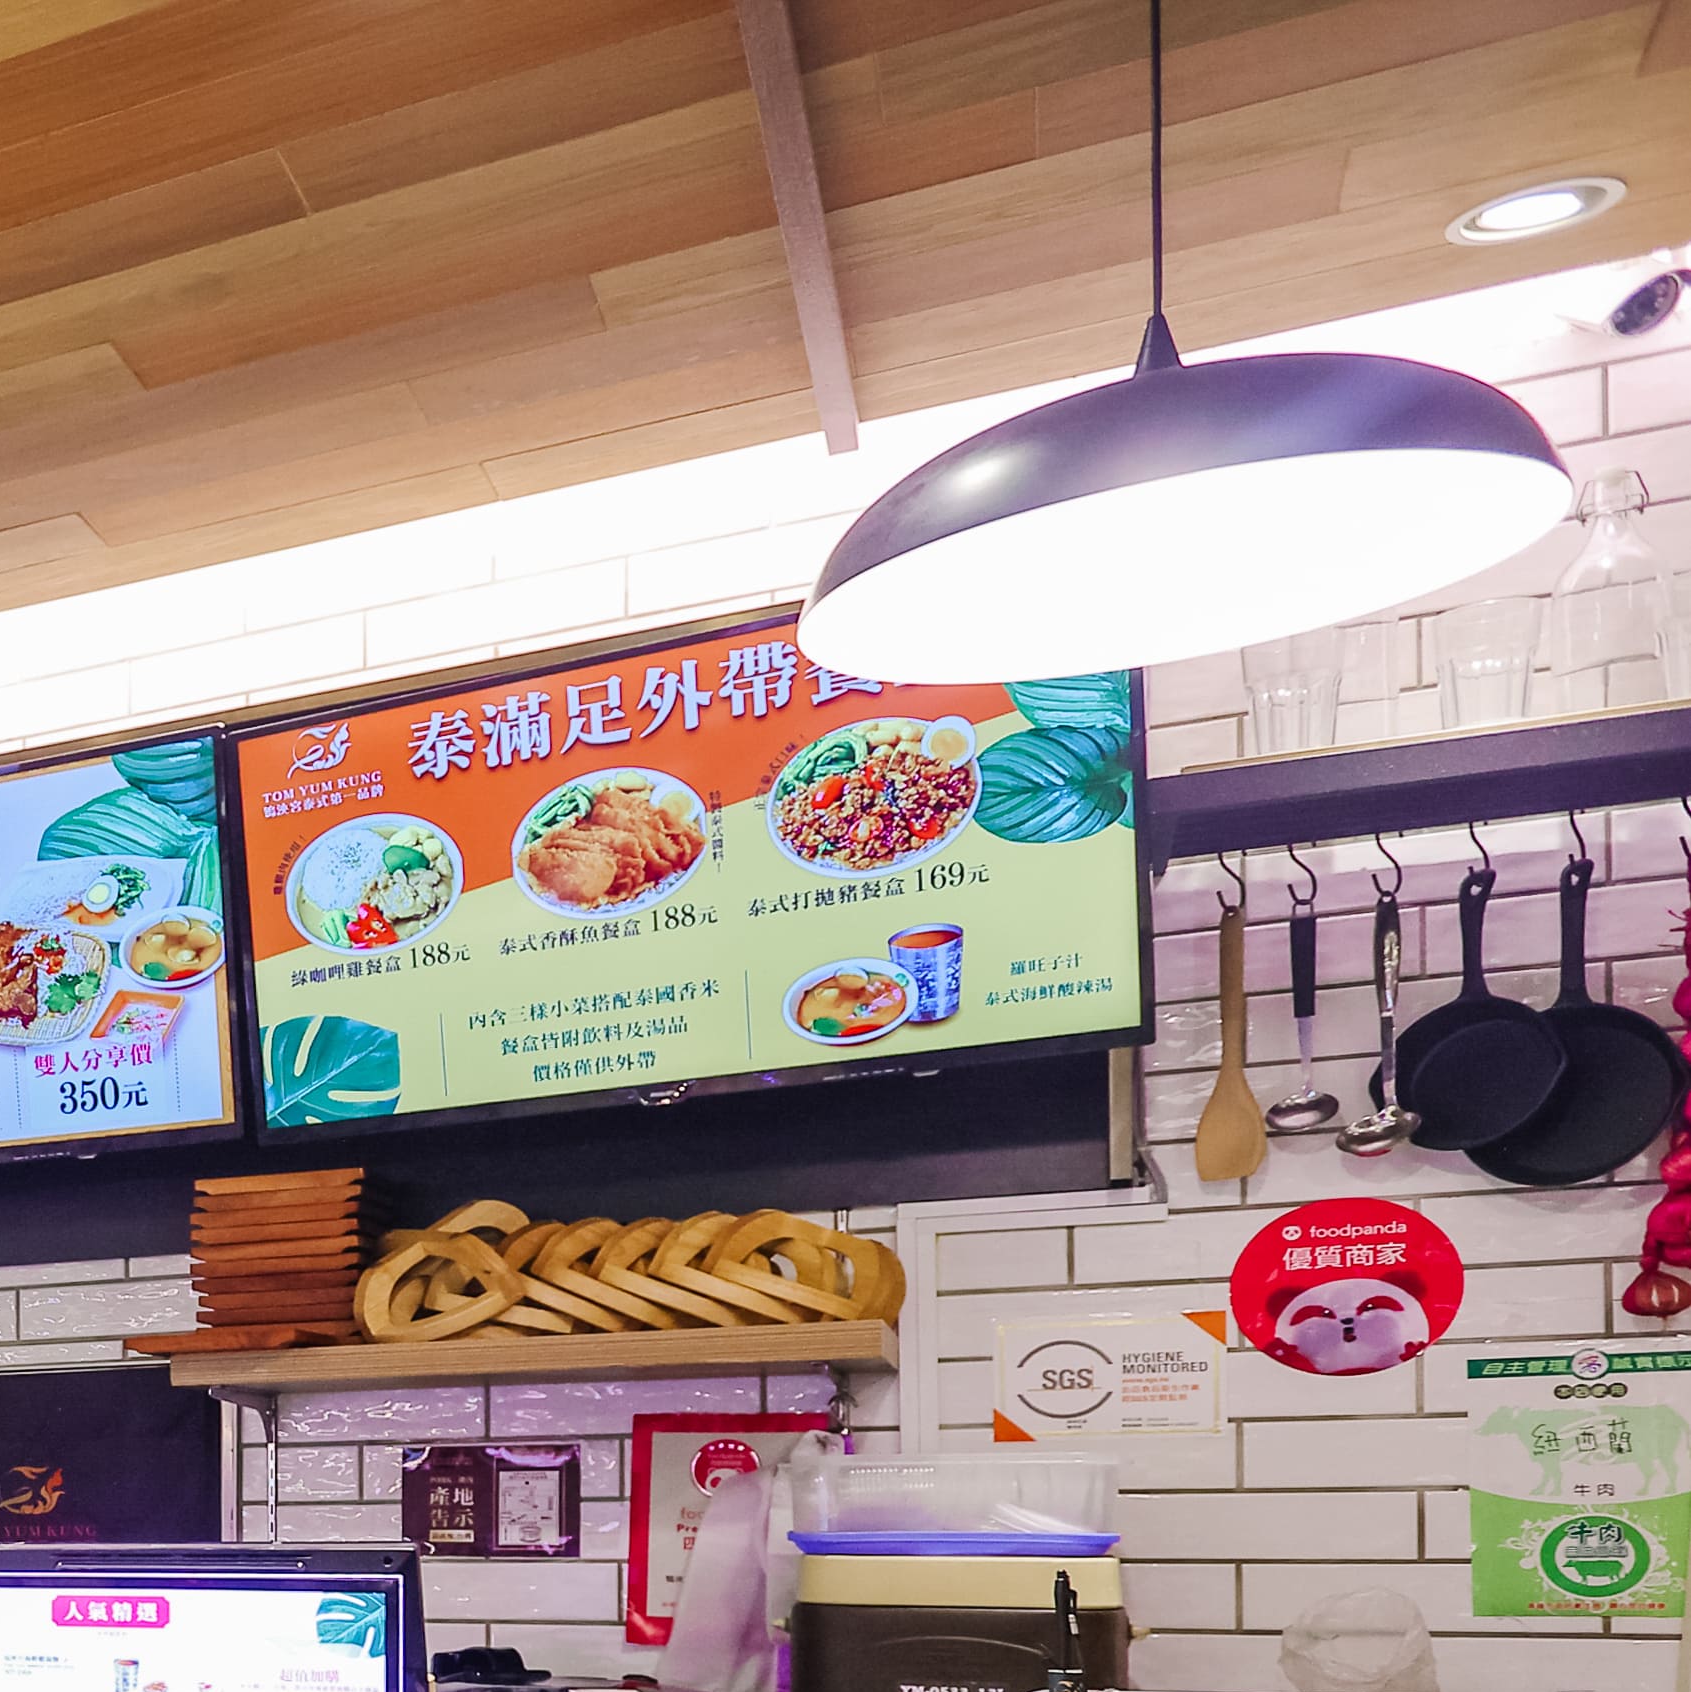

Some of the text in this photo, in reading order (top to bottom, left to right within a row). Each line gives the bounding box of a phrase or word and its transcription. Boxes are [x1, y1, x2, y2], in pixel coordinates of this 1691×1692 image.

[262, 770, 382, 804] TOM YUM KUNG
[914, 861, 990, 893] 169元
[499, 903, 719, 956] 泰式香酥魚餐盒 188元
[410, 941, 470, 970] 188元
[984, 977, 1114, 1007] 泰式海鮮酸辣湯
[500, 1015, 689, 1056] 餐盒皆附飲料及湯品
[33, 1042, 153, 1079] 雙人分享價
[532, 1051, 657, 1082] 價格僅供外帶
[58, 1075, 150, 1115] 350元
[1309, 1221, 1407, 1239] foodpanda
[1282, 1242, 1407, 1271] 優質商家
[1122, 1351, 1184, 1363] HYGIENE
[1122, 1362, 1209, 1375] MONITORED
[1042, 1369, 1094, 1390] SGS
[1531, 1418, 1633, 1456] 紐西蘭
[430, 1486, 475, 1506] 產地
[1573, 1483, 1615, 1497] 牛肉
[430, 1509, 474, 1528] 告示
[1567, 1521, 1625, 1544] 牛肉
[63, 1600, 159, 1623] 人氣精選
